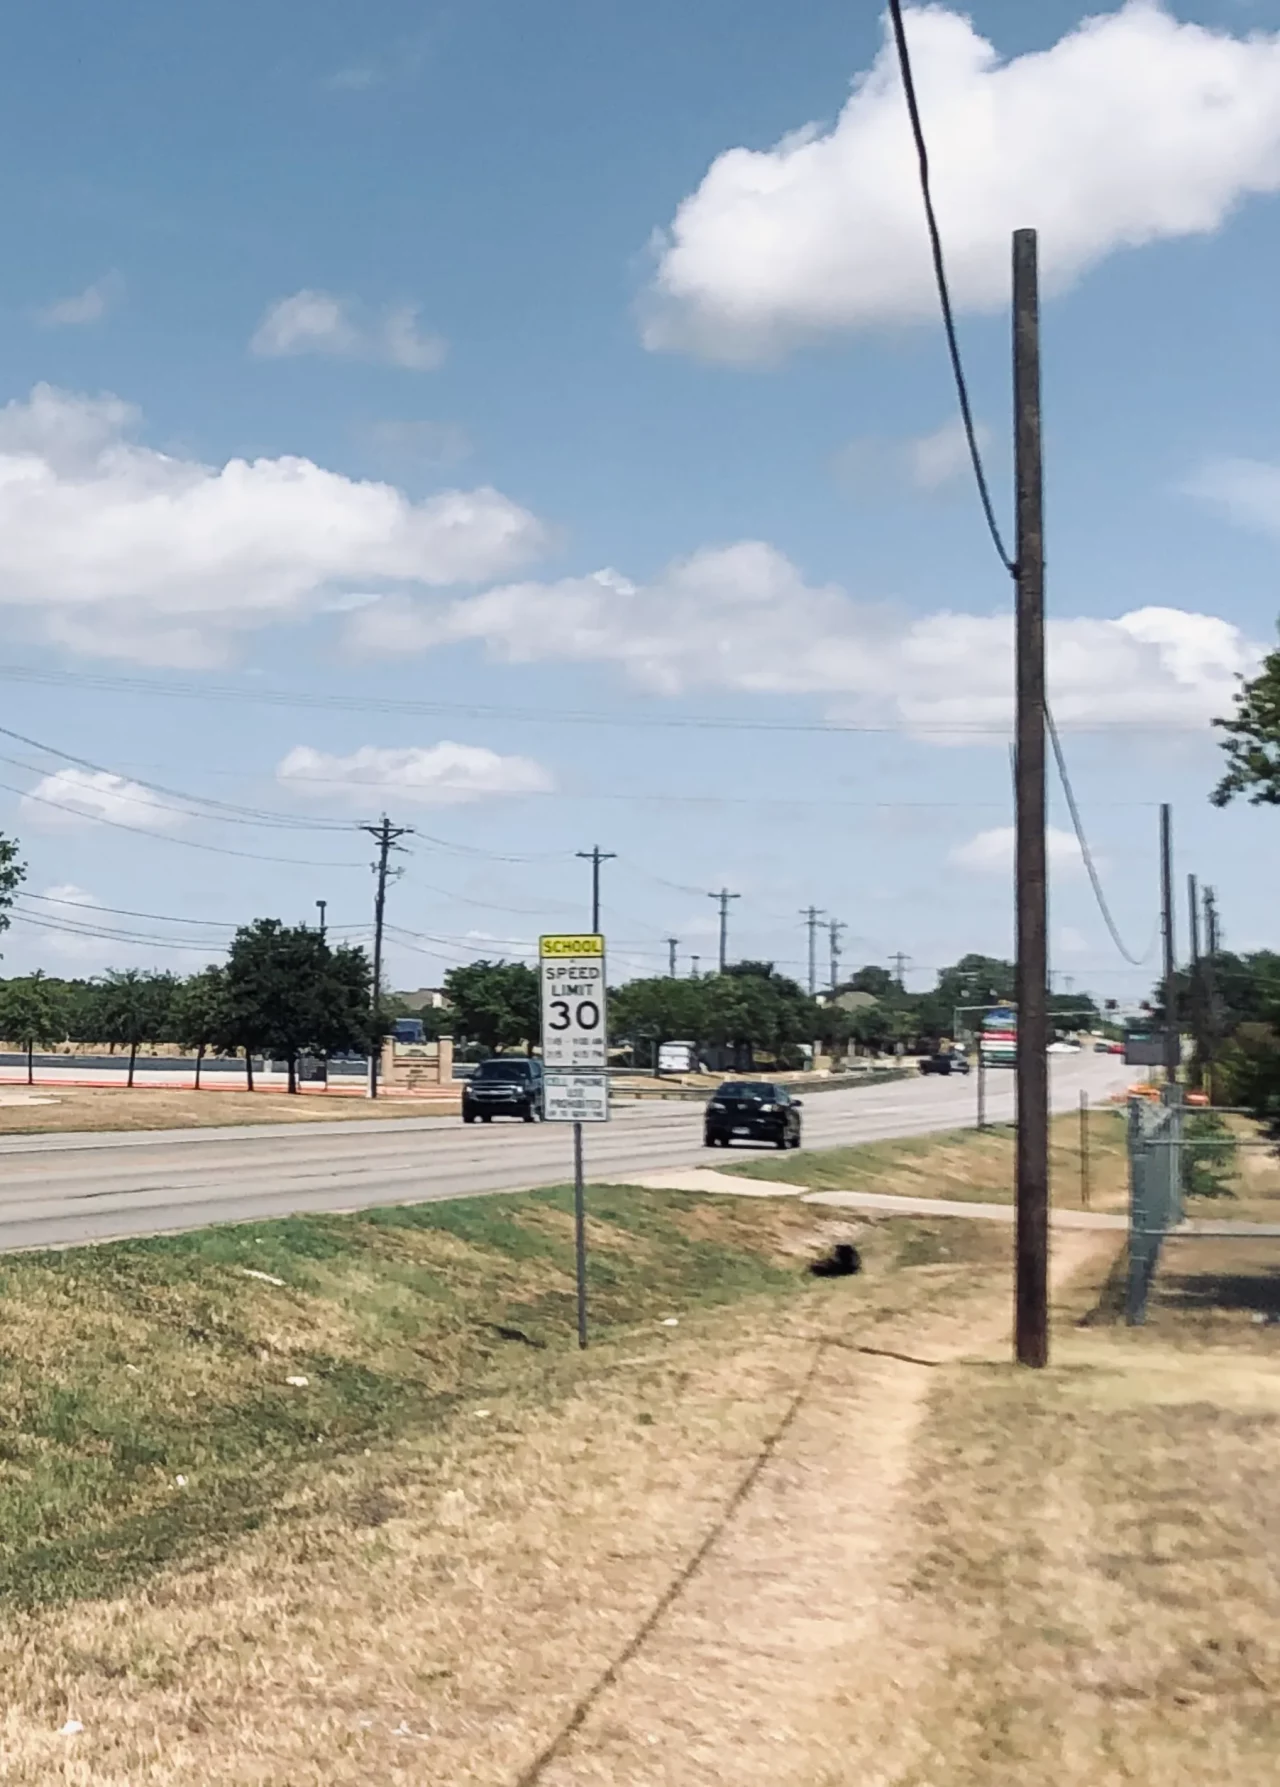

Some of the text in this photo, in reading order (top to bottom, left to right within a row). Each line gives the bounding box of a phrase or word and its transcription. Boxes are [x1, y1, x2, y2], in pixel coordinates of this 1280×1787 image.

[544, 940, 602, 953] SCHOOL
[546, 967, 600, 980] SPEED
[551, 984, 593, 997] LIMIT
[548, 1000, 600, 1030] 30
